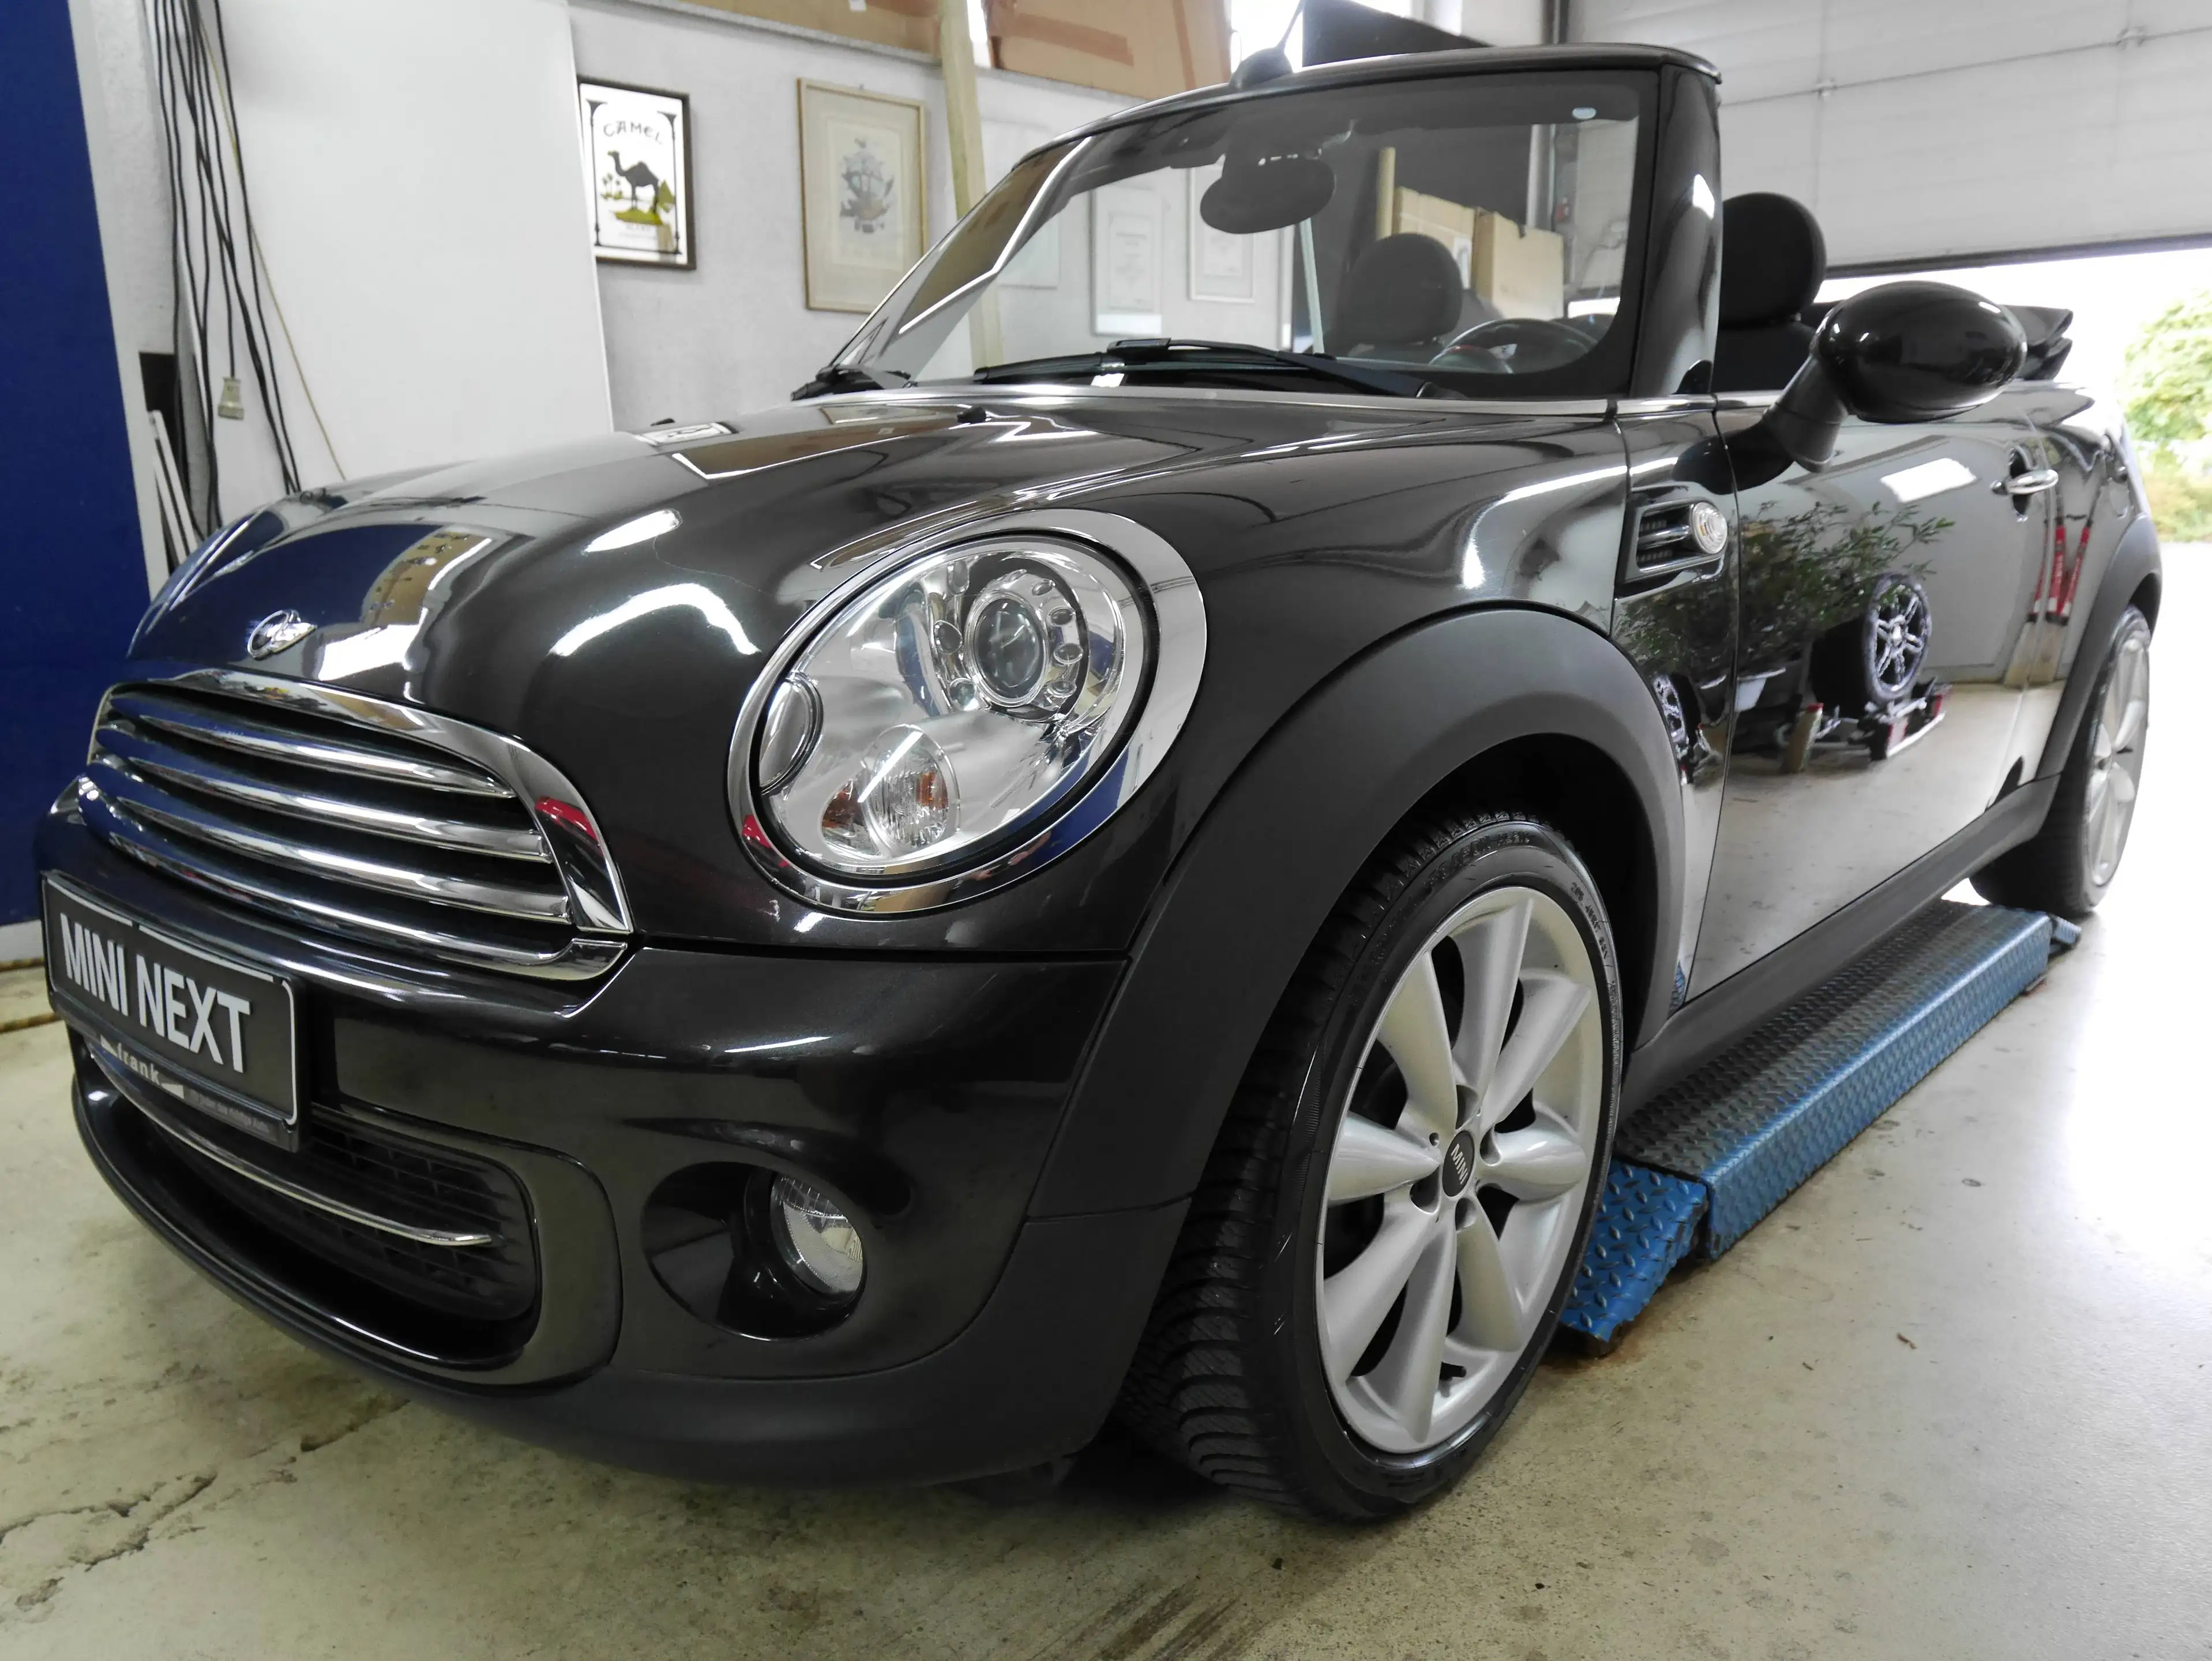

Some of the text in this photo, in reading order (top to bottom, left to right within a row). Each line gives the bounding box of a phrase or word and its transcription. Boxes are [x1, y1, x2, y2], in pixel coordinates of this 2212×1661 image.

[60, 912, 251, 1073] MINI NEXT
[1451, 1143, 1469, 1185] MINI
